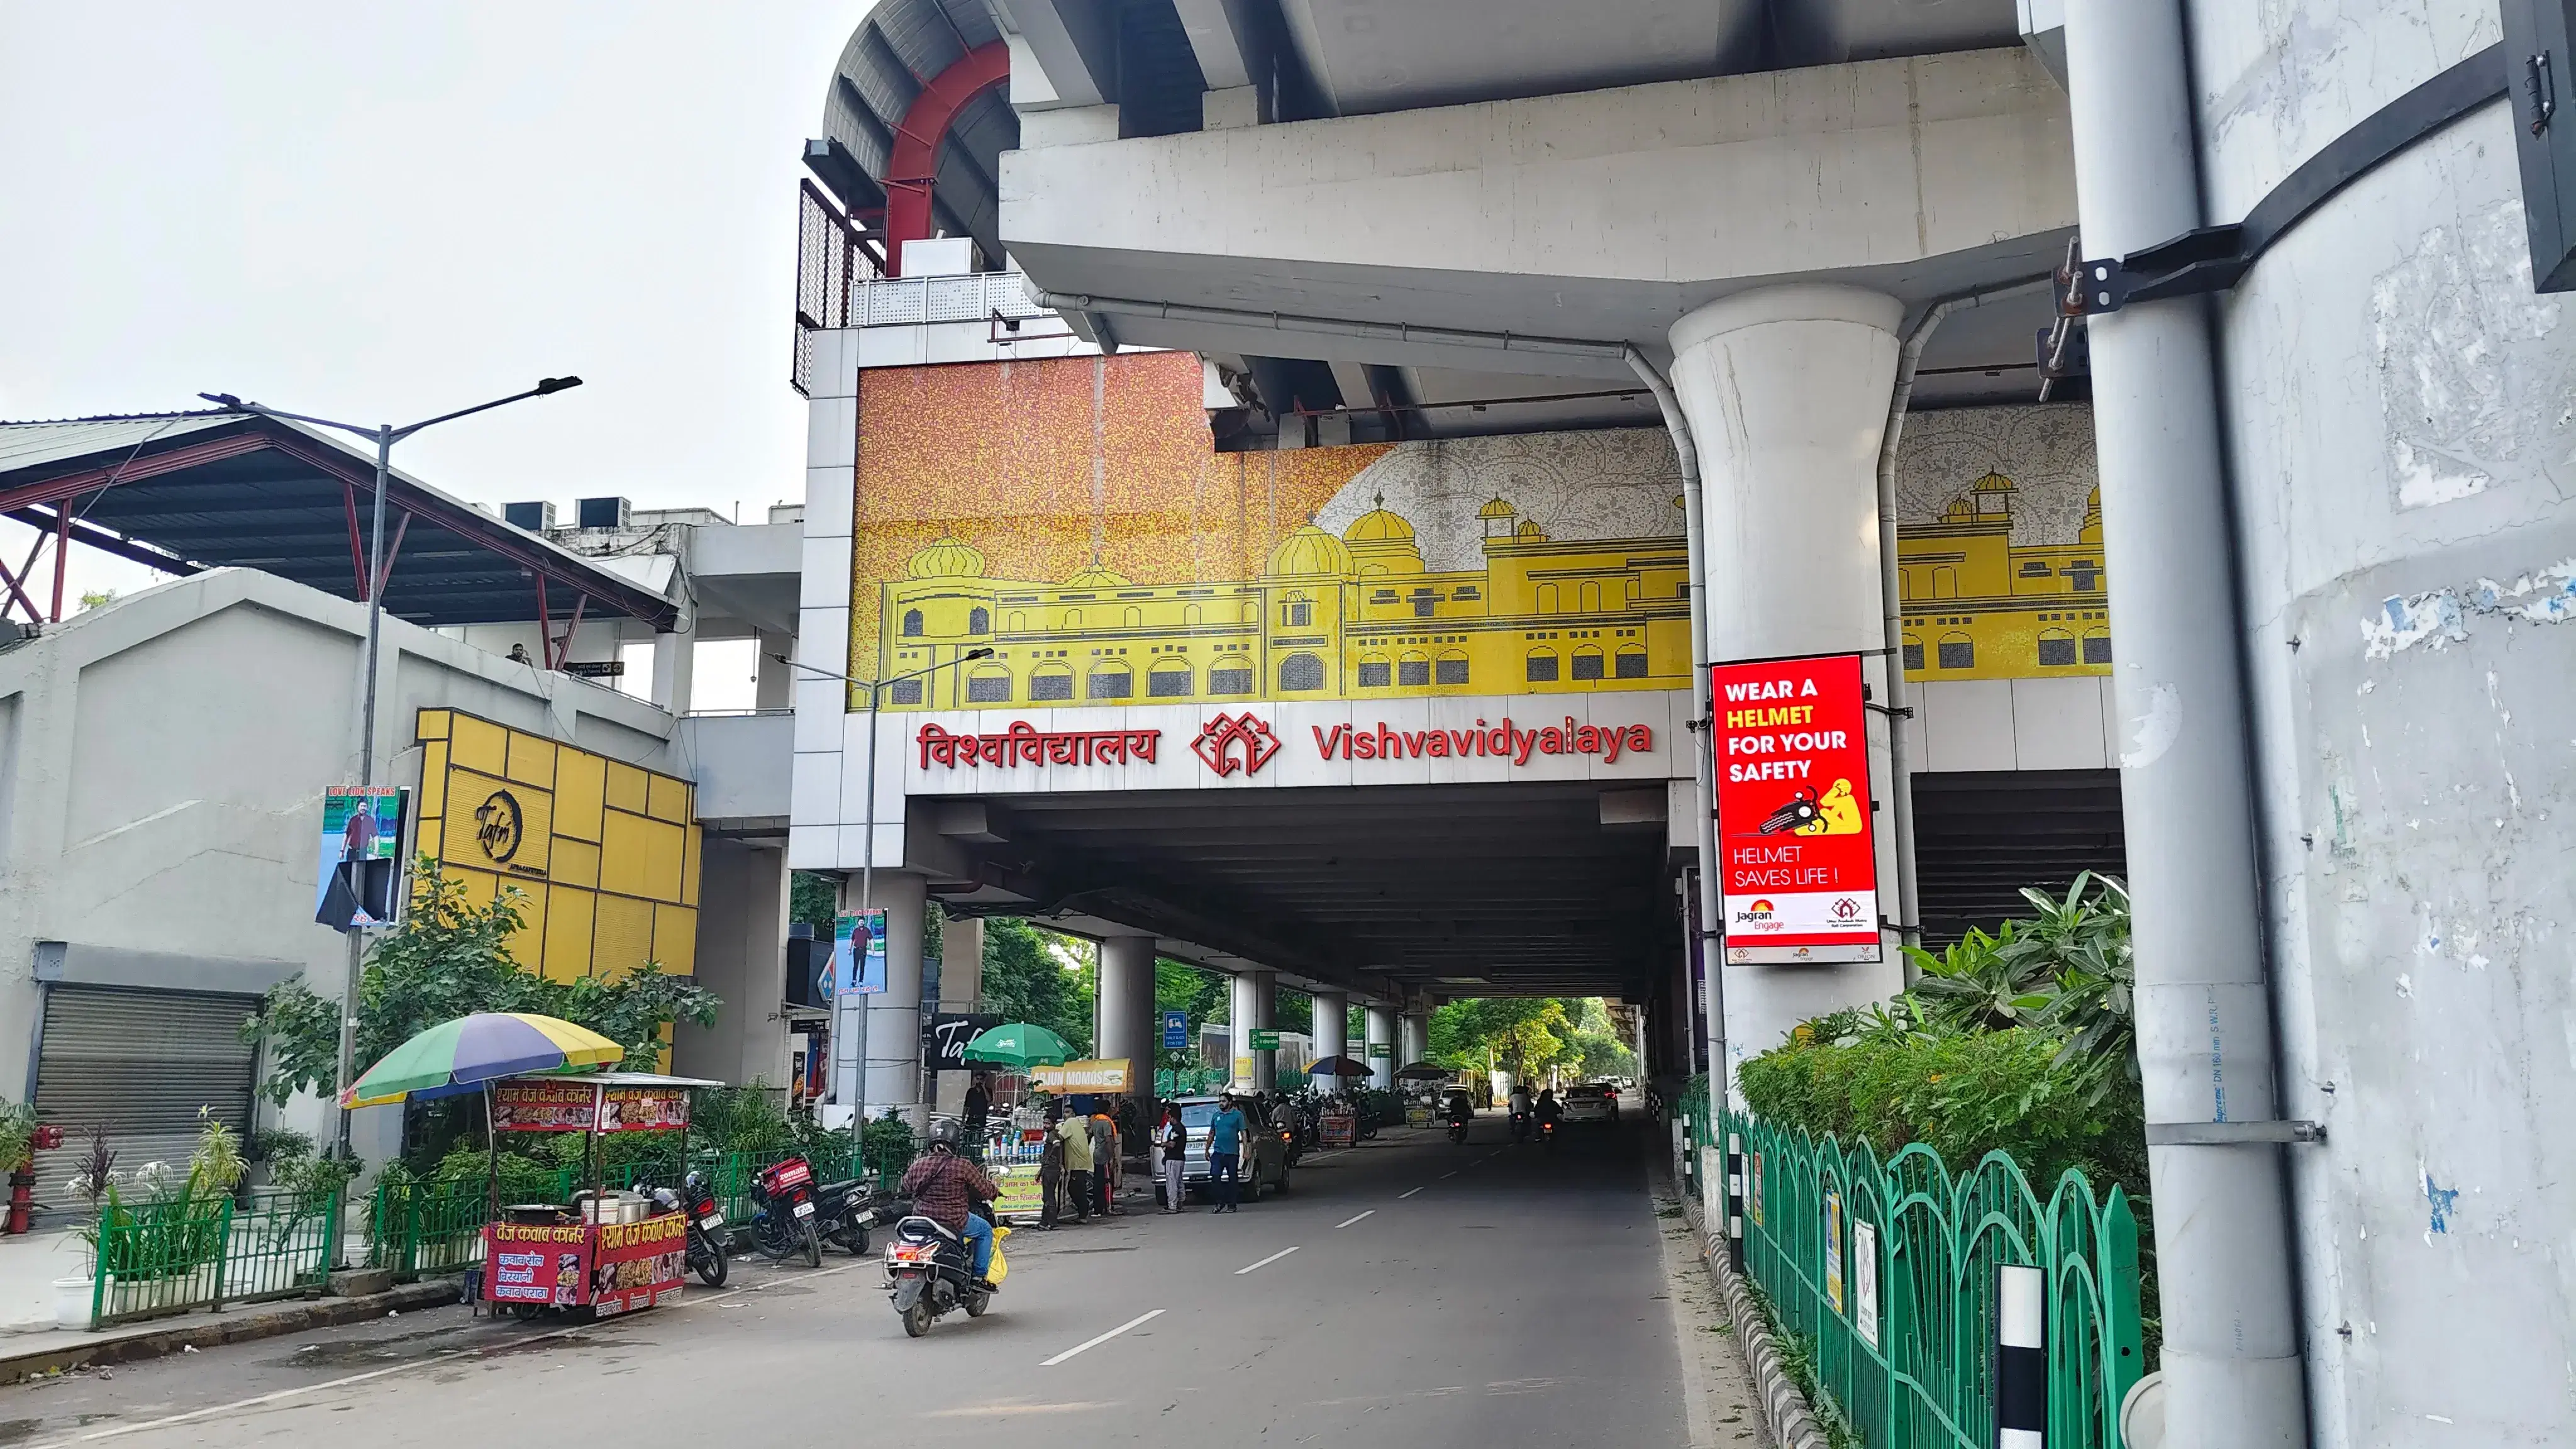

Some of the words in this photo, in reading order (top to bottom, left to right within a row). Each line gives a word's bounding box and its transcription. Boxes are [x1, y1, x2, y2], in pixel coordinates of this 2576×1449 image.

[1724, 680, 1793, 702] WEAR
[1801, 679, 1818, 697] A
[1727, 705, 1814, 729] HELMET
[917, 721, 1161, 769] विश्वविद्यालय
[1311, 716, 1652, 767] Vishvavidyalaya
[1728, 735, 1775, 755] FOR
[1780, 730, 1847, 752] YOUR
[1729, 760, 1812, 782] SAFETY
[328, 787, 347, 796] LOVE
[347, 787, 365, 796] LION
[367, 787, 396, 796] SPEAKS
[1733, 846, 1803, 865] HELMET
[1735, 869, 1790, 887] SAVES
[1795, 867, 1828, 885] LIFE
[1735, 912, 1772, 923] Jagran
[1754, 921, 1784, 931] Engage
[935, 1019, 984, 1066] Taf
[2212, 1036, 2220, 1051] mm
[2212, 1053, 2222, 1067] 160
[1033, 1071, 1063, 1085] ARJUN
[1066, 1071, 1103, 1085] MOMOS
[2213, 1069, 2222, 1082] DN
[2212, 1087, 2223, 1123] Supreme
[780, 1166, 808, 1180] zomato
[496, 1223, 516, 1241] वेज
[601, 1224, 624, 1250] श्याम
